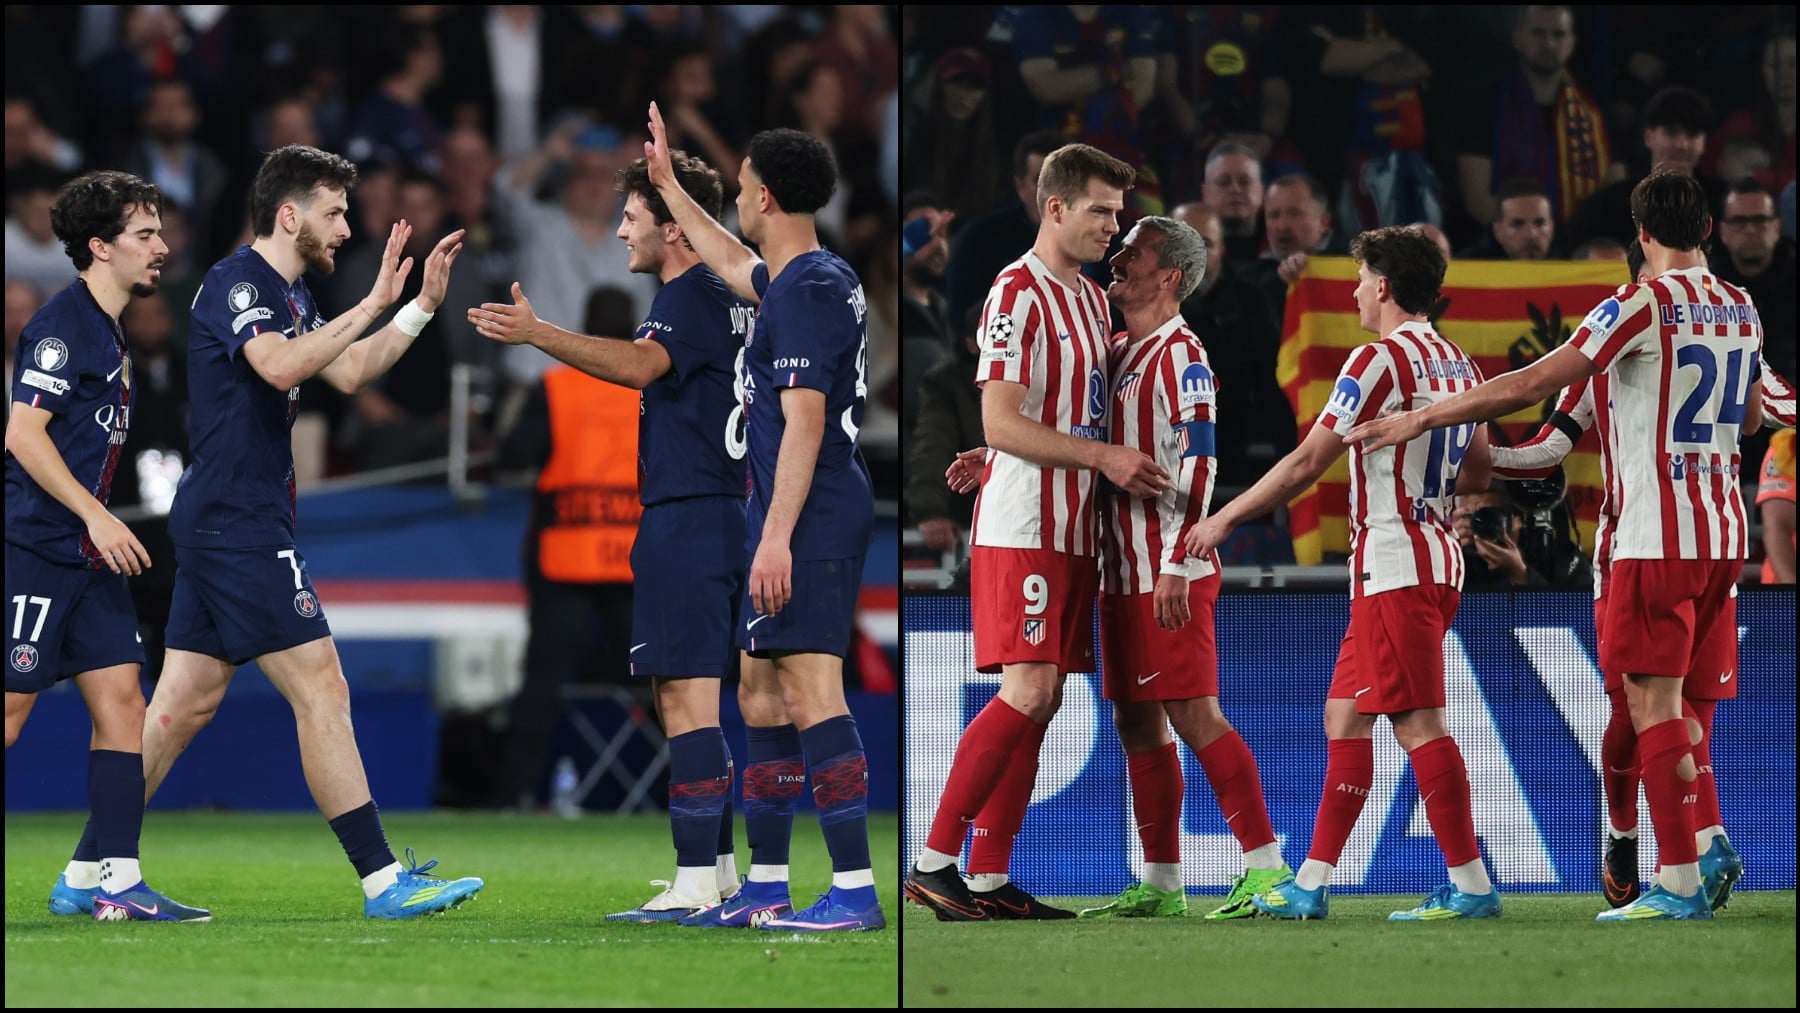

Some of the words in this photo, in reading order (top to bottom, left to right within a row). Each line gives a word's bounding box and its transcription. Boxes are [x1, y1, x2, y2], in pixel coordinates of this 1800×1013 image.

[1661, 304, 1685, 325] LE
[1413, 360, 1428, 380] J.
[1673, 344, 1759, 446] 24
[277, 549, 304, 590] 7
[1023, 574, 1048, 615] 9
[12, 594, 52, 642] 17
